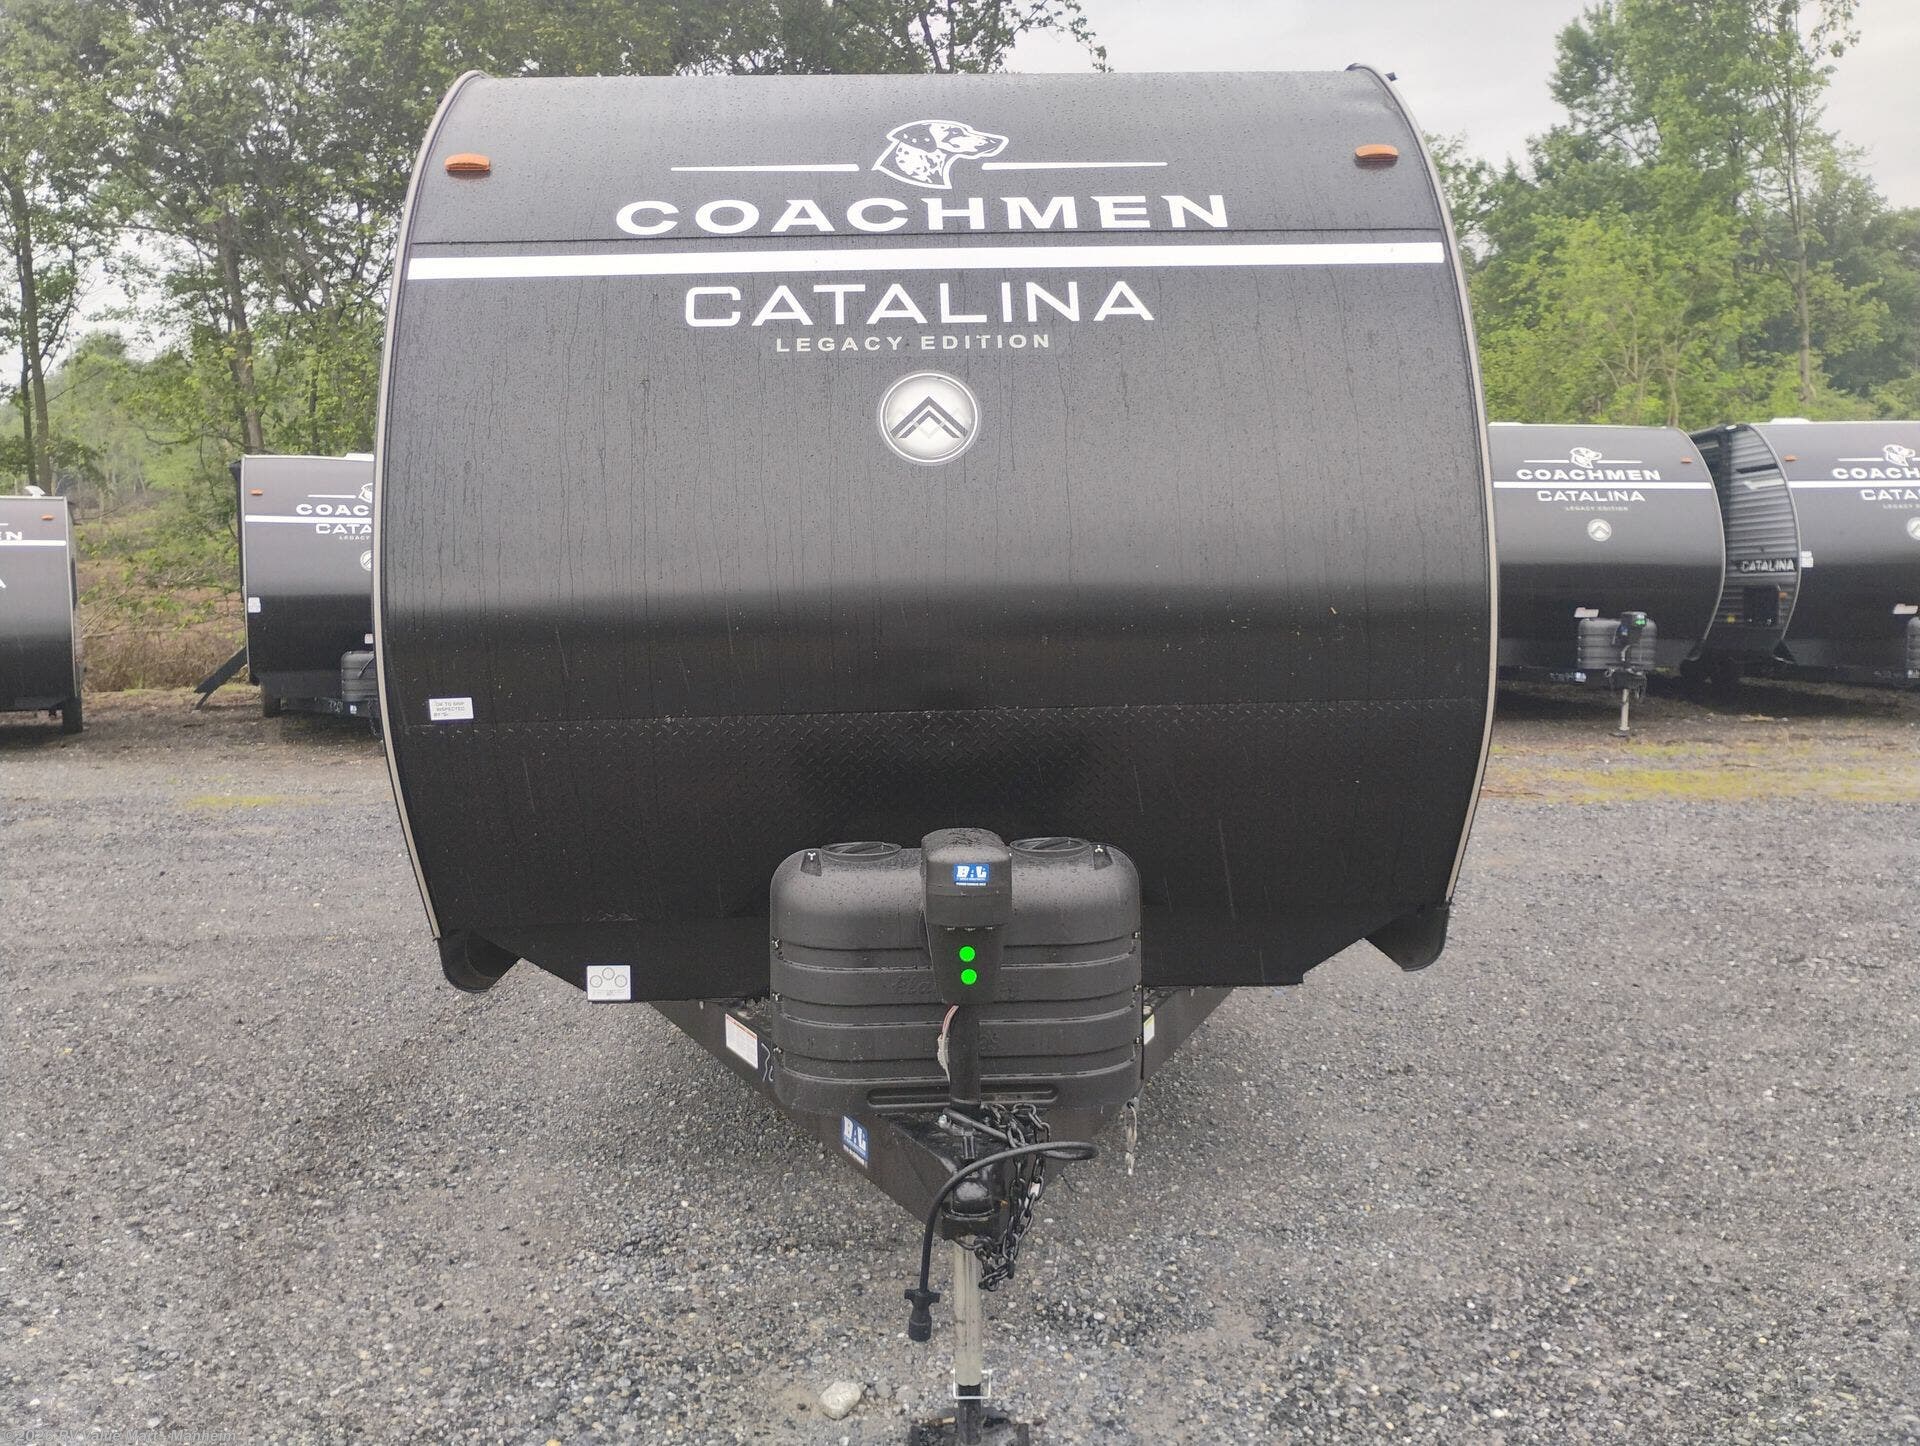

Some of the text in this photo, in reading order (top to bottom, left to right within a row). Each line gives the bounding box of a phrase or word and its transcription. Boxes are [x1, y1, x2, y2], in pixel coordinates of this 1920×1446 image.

[616, 195, 1228, 235] COACHMEN
[684, 281, 1155, 329] CATALINA
[775, 333, 1051, 354] LEGACY EDITION
[1515, 468, 1662, 482] COACHMEN
[1536, 489, 1647, 503] CATALINA
[1741, 558, 1796, 574] CATALINA
